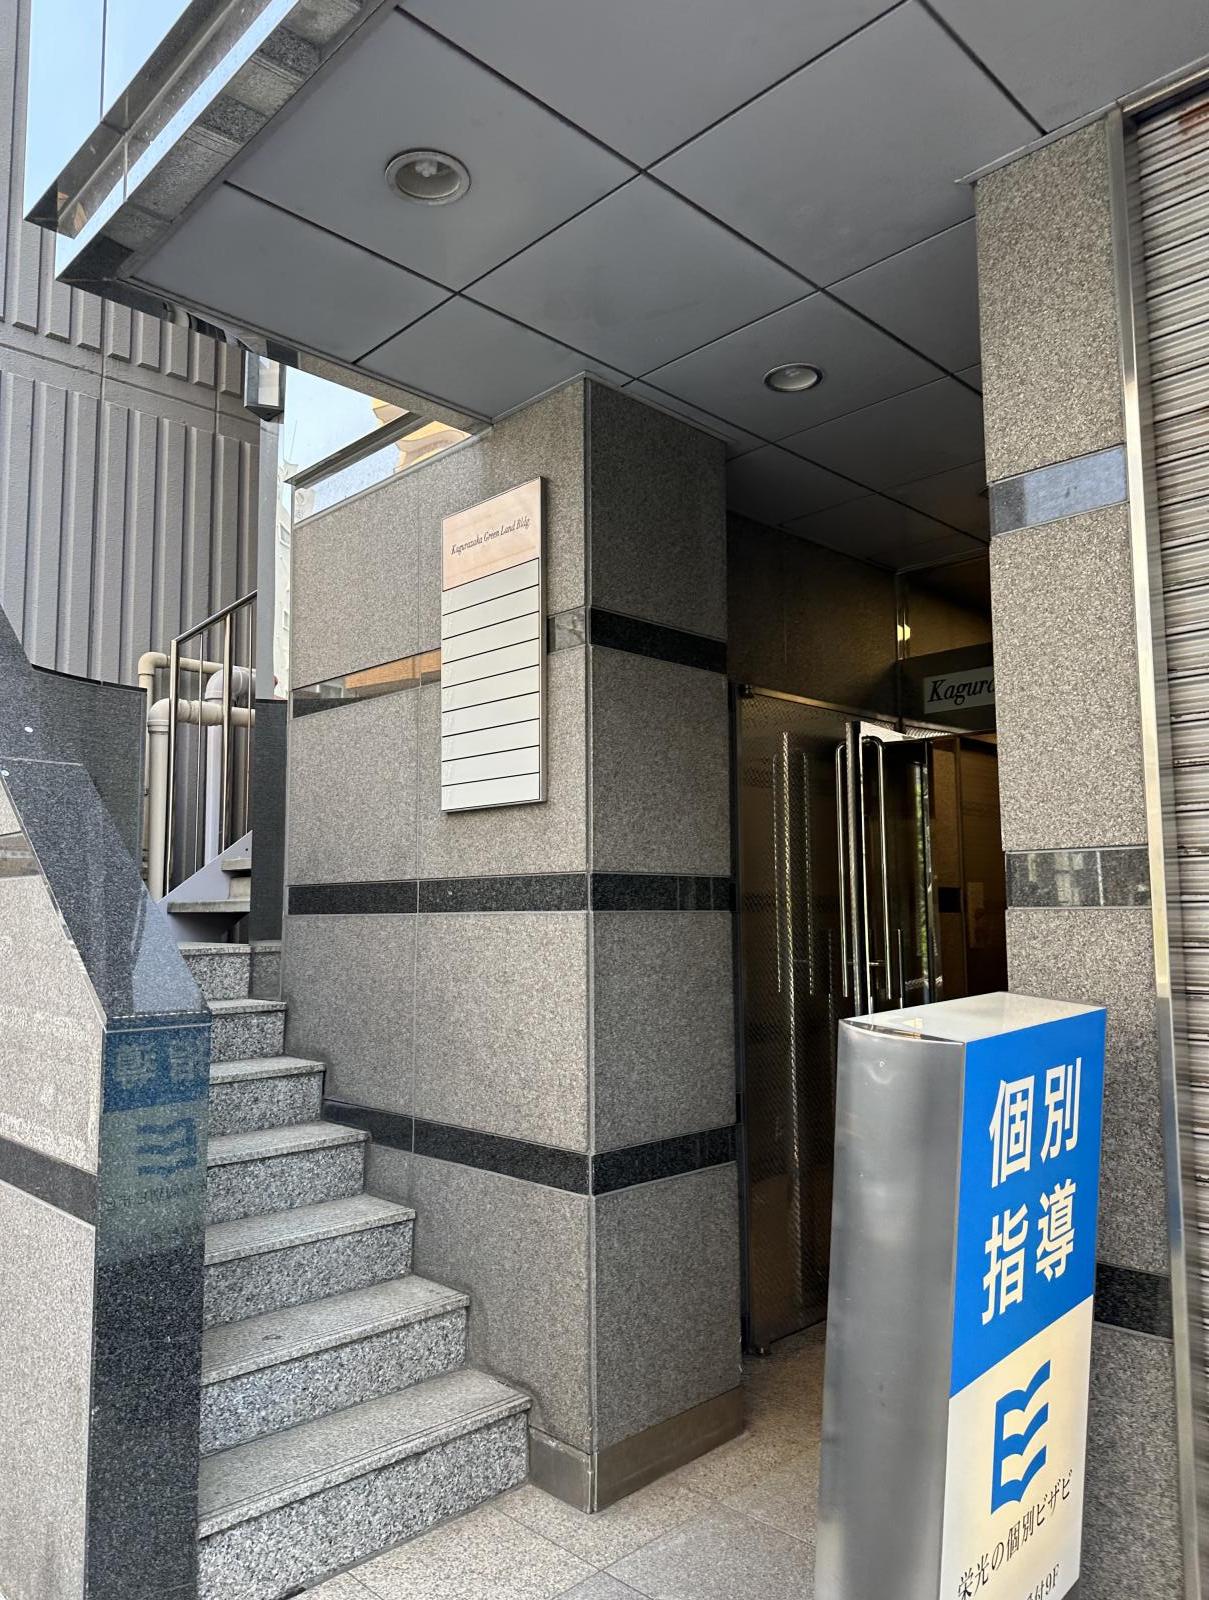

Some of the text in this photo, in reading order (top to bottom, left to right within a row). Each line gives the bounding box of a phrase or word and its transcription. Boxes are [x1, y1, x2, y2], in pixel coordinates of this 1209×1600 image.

[483, 530, 500, 542] Green
[500, 521, 516, 537] Land
[988, 1057, 1082, 1188] 個別
[982, 1178, 1077, 1326] 指導
[957, 1469, 1073, 1600] 栄光の個別ビザビ
